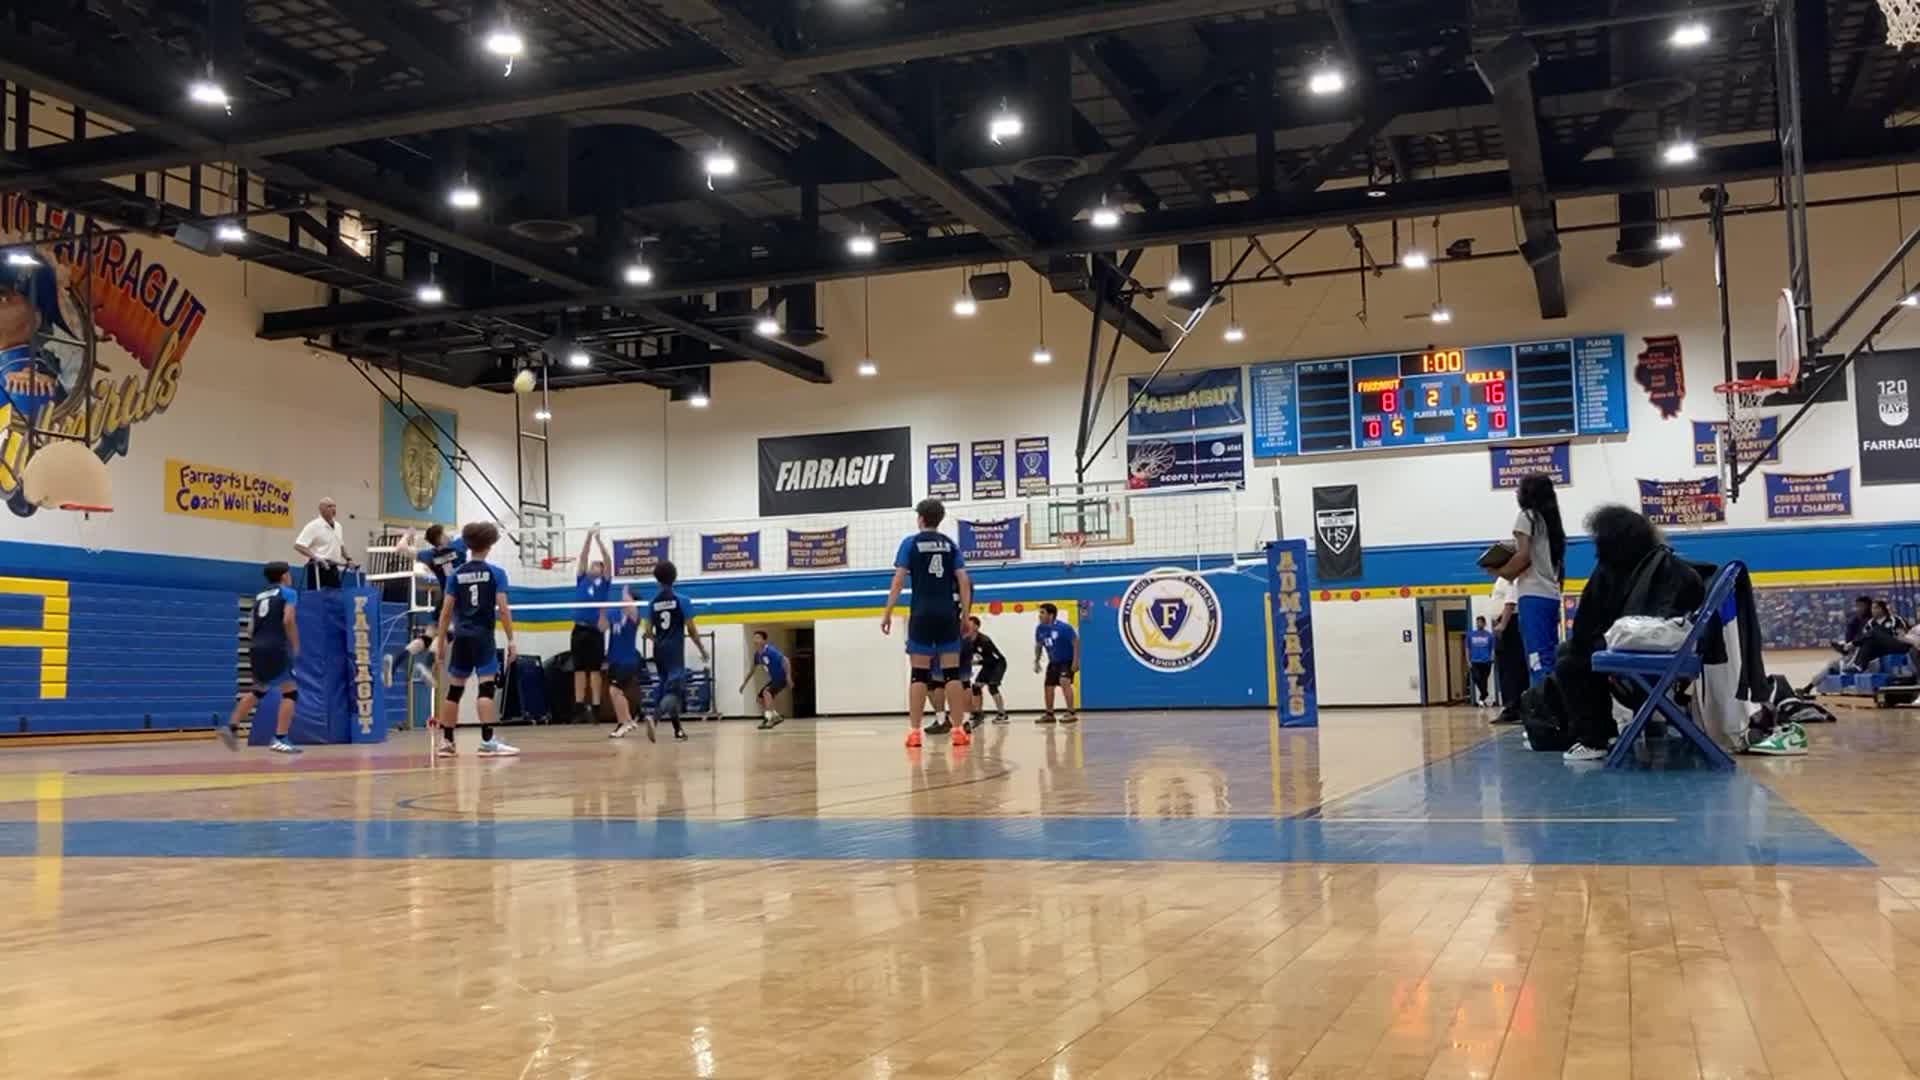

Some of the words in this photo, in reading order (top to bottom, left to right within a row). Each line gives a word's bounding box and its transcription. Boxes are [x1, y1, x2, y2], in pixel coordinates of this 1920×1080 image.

[1423, 351, 1461, 373] 1:00
[1465, 371, 1505, 383] WELLS
[1877, 379, 1908, 395] 120
[1134, 386, 1238, 414] FARRAGUT
[1382, 392, 1395, 412] 8
[1426, 390, 1439, 407] 2
[1486, 384, 1505, 404] 16
[1369, 422, 1380, 438] 0
[1391, 419, 1403, 436] 5
[1465, 414, 1478, 431] 5
[1495, 412, 1506, 429] 0
[775, 453, 895, 492] FARRAGUT
[1160, 473, 1189, 482] score
[243, 475, 291, 502] Legend
[1804, 493, 1842, 503] COUNTRY
[176, 487, 220, 511] Coach
[1774, 505, 1798, 514] CITY
[1802, 503, 1845, 513] CHAMPS
[1649, 514, 1672, 523] CITY
[928, 554, 944, 578] 4
[660, 610, 671, 630] 3
[1160, 602, 1179, 629] F
[1276, 551, 1306, 717] ADMIRALS
[353, 595, 374, 735] FARRAGUT
